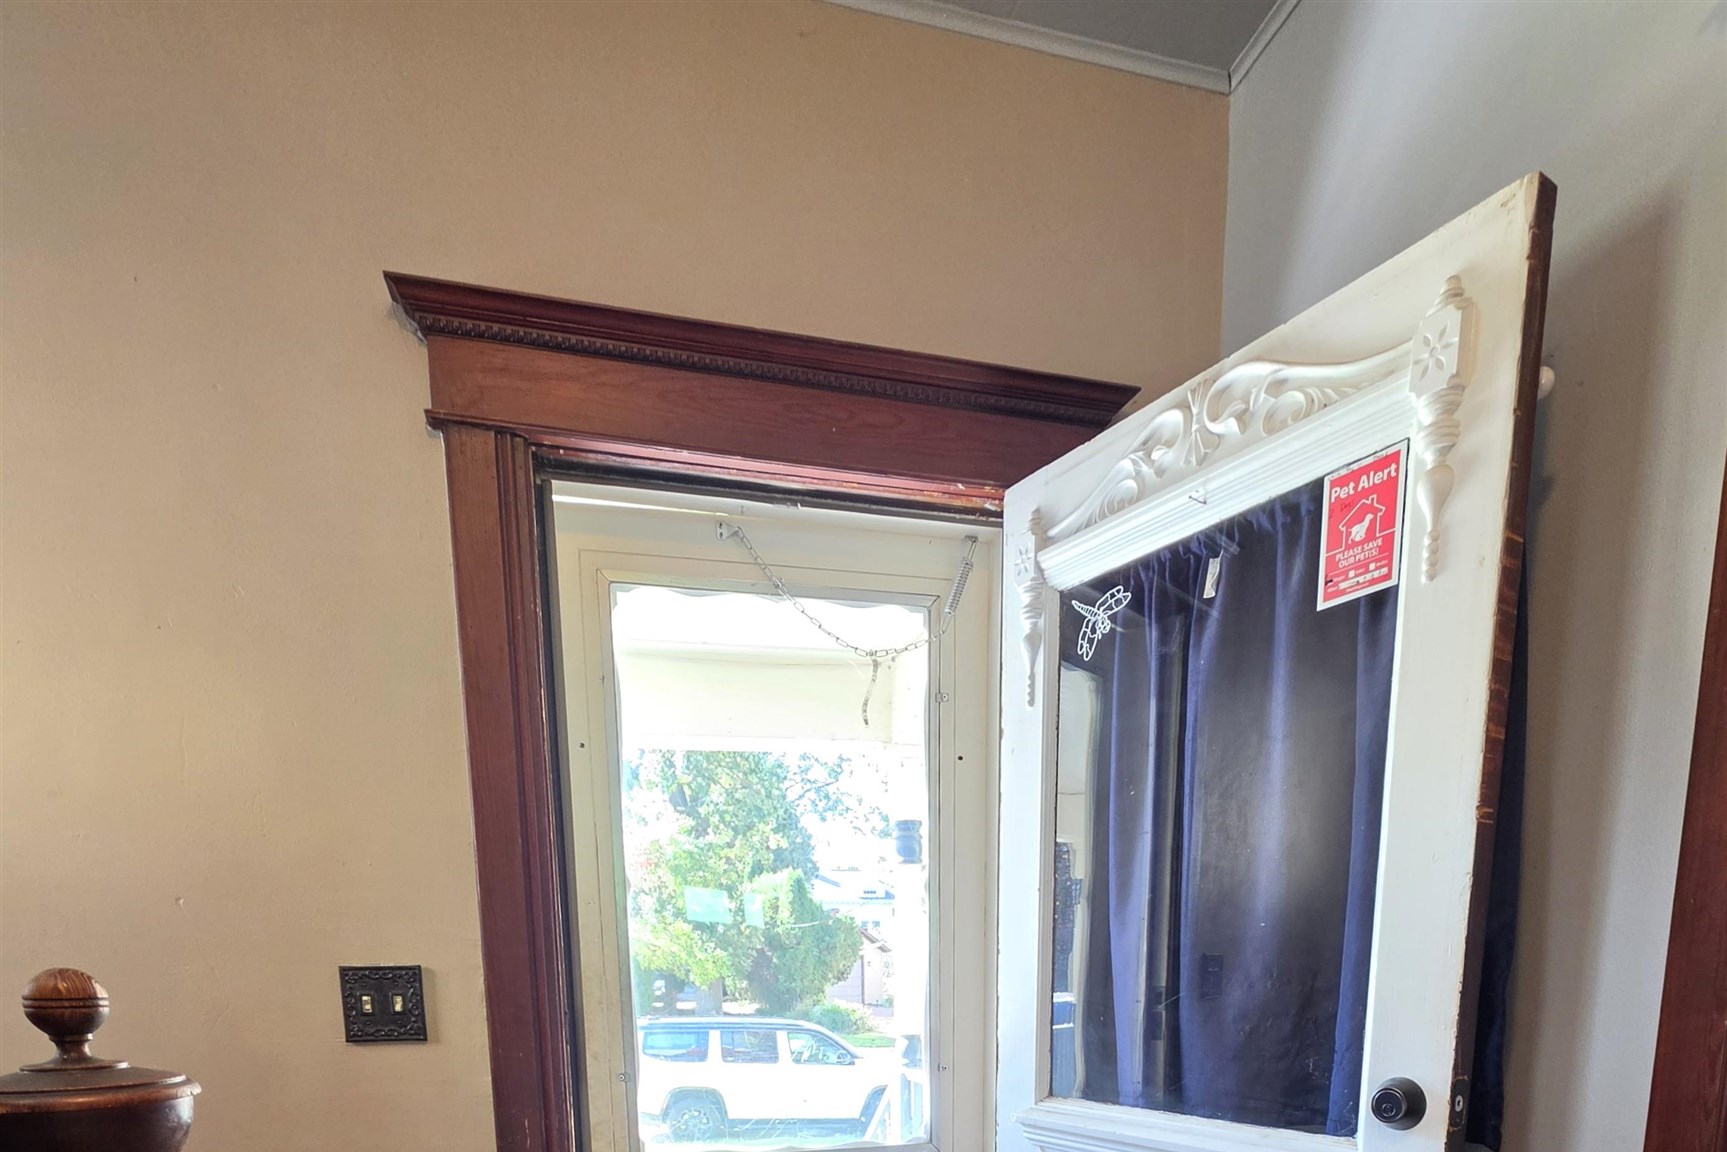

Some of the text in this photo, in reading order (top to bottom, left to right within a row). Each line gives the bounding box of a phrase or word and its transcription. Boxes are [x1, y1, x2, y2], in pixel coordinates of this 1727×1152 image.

[1331, 481, 1355, 503] Pet
[1357, 462, 1397, 492] Alert
[1336, 537, 1383, 562] PLEASE SAVE
[1338, 548, 1379, 568] OUR PET(S)
